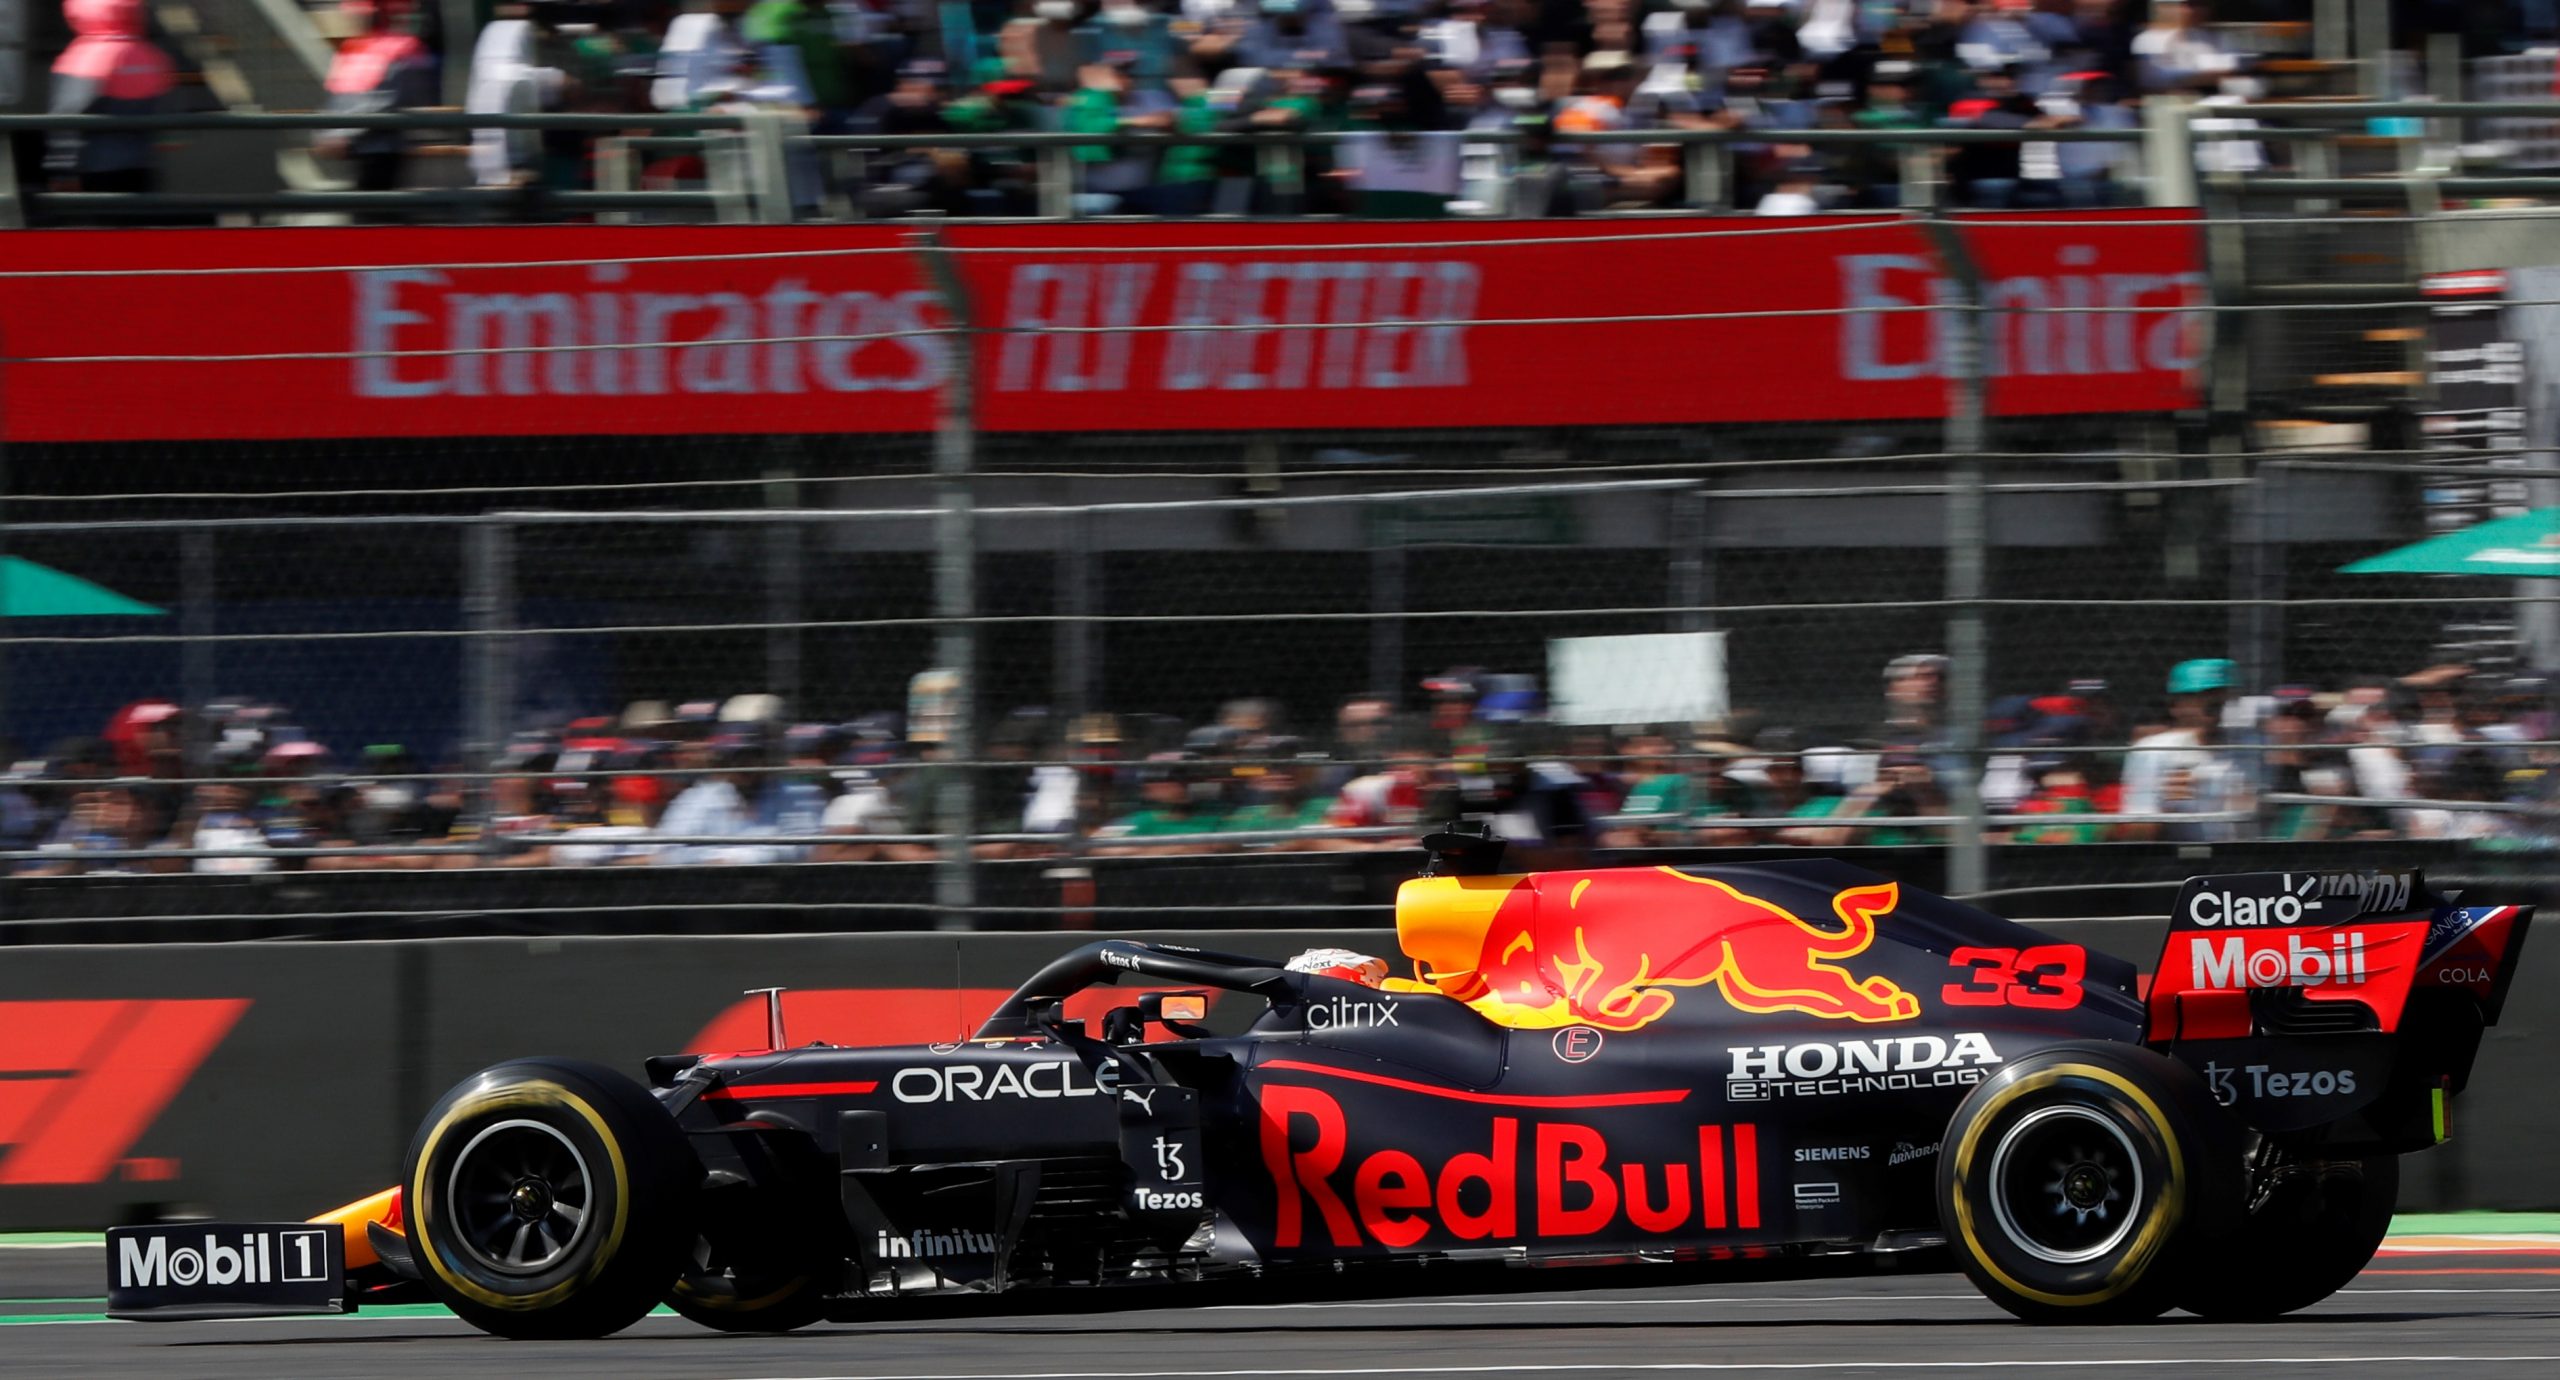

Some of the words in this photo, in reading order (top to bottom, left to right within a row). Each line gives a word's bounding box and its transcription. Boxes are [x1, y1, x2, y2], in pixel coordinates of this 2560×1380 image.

[350, 263, 948, 397] Emirates
[2190, 889, 2303, 927] Claro
[1941, 944, 2086, 1010] 33
[2190, 932, 2366, 988] Mobil
[2439, 968, 2490, 983] COLA
[1307, 995, 1398, 1029] citrix
[1727, 1032, 2003, 1080] HONDA
[892, 1057, 1120, 1104] ORACLE
[2245, 1065, 2357, 1099] Tezos
[1795, 1146, 1870, 1162] SIEMENS
[1888, 1142, 1942, 1166] ARMORA
[1135, 1187, 1204, 1210] Tezos
[119, 1232, 271, 1287] Mobil
[295, 1235, 312, 1277] 1
[878, 1228, 998, 1258] infinitu
